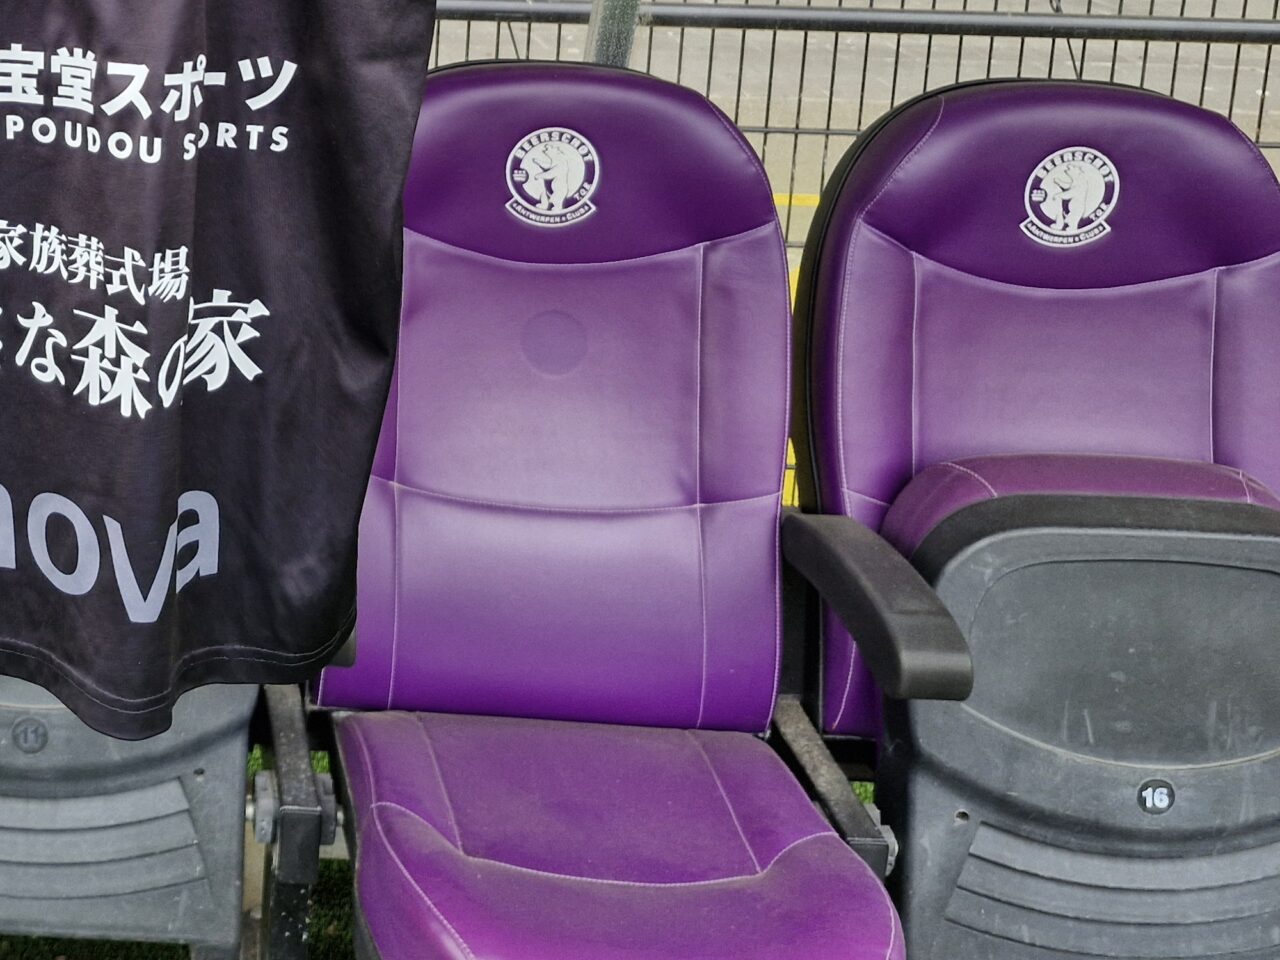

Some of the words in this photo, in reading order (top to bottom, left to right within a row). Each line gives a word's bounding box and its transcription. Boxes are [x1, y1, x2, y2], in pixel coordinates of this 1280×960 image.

[183, 122, 289, 161] SRTS
[514, 131, 593, 162] BEERSCHOT
[1142, 787, 1170, 809] 16
